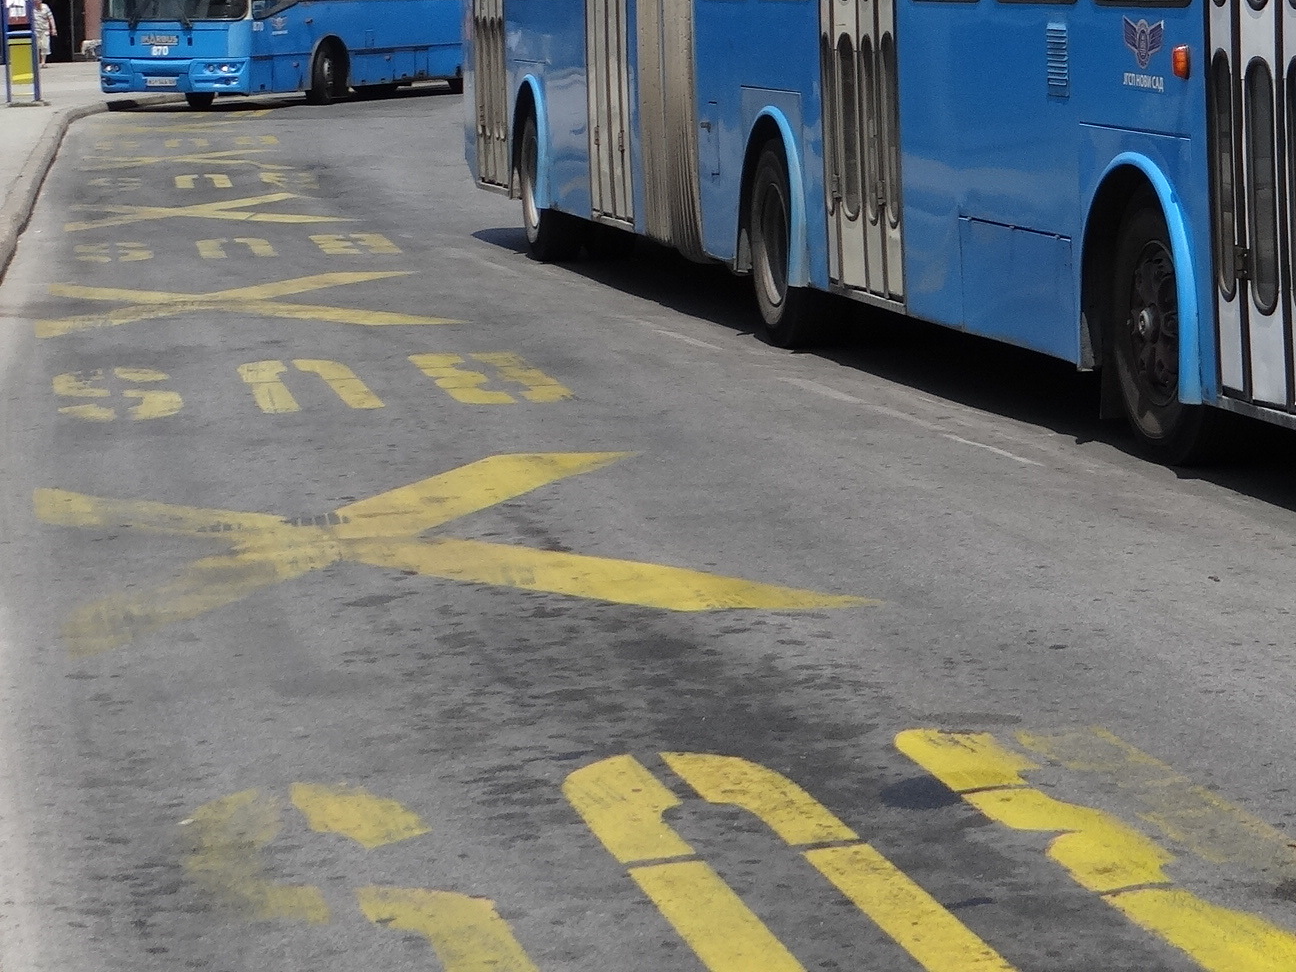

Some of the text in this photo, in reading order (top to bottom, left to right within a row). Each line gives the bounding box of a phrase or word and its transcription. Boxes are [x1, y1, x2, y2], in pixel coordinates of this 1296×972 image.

[151, 46, 169, 55] 870
[1136, 74, 1152, 88] НОВИ
[1152, 76, 1164, 92] САД
[74, 234, 402, 262] BUS
[52, 352, 577, 423] BUS
